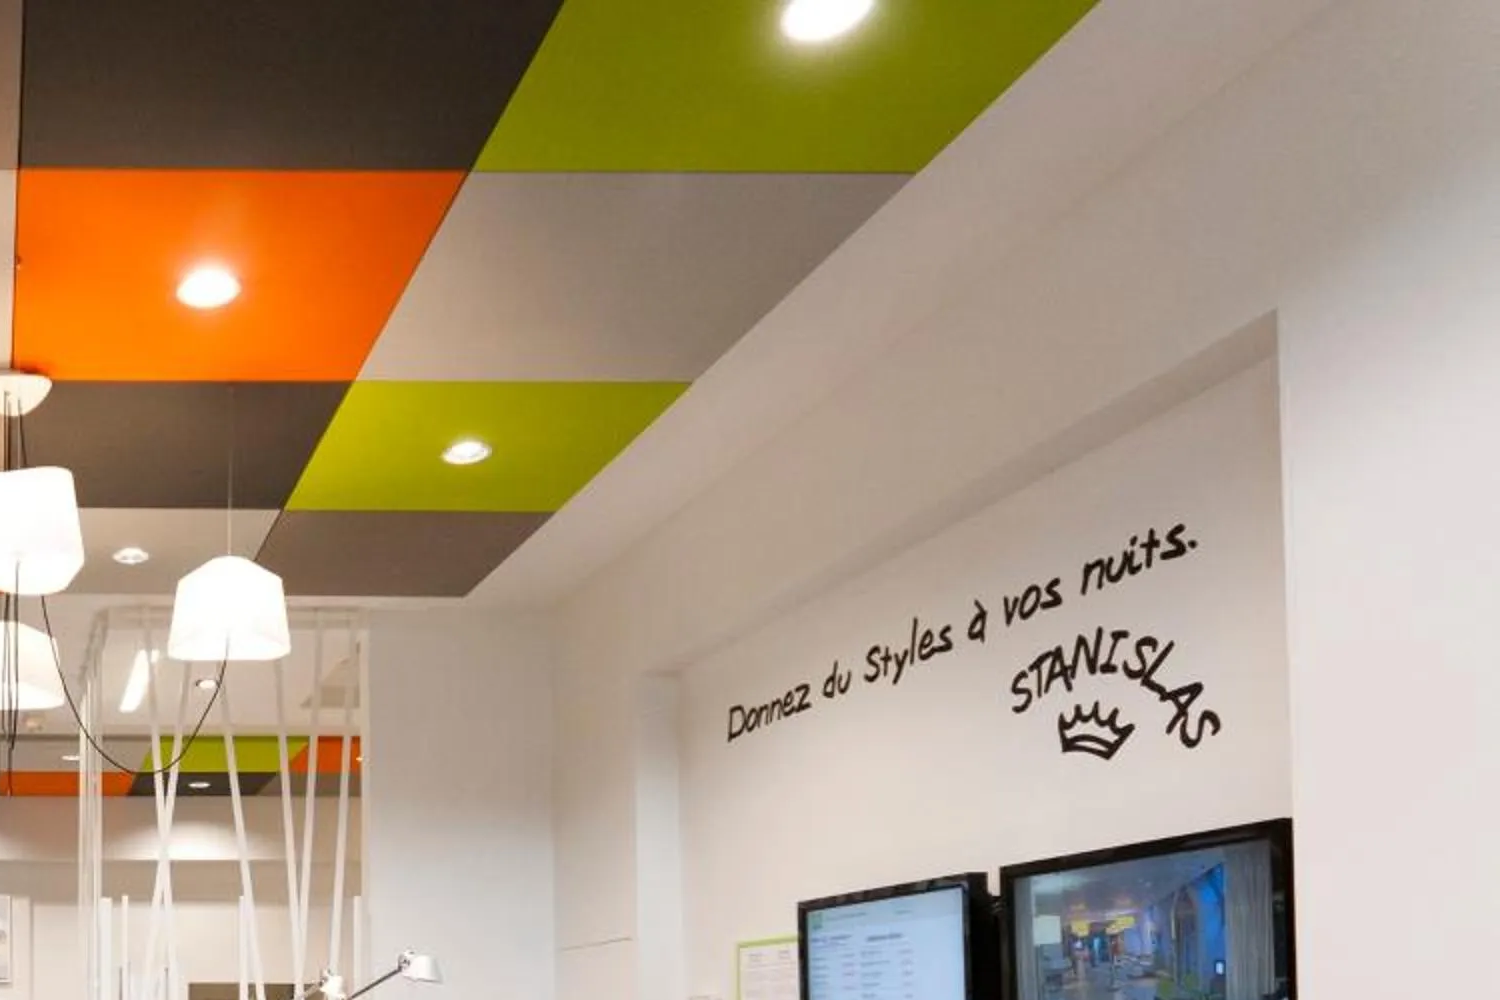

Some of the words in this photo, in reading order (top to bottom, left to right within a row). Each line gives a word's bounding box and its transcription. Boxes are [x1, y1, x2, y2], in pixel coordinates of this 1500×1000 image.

[727, 682, 812, 742] Donnez
[822, 661, 852, 699] du
[863, 618, 954, 685] Styles
[967, 600, 988, 642] à
[1003, 577, 1063, 627] vos
[1080, 522, 1198, 596] nuits.
[1011, 626, 1221, 749] STANISLAS
